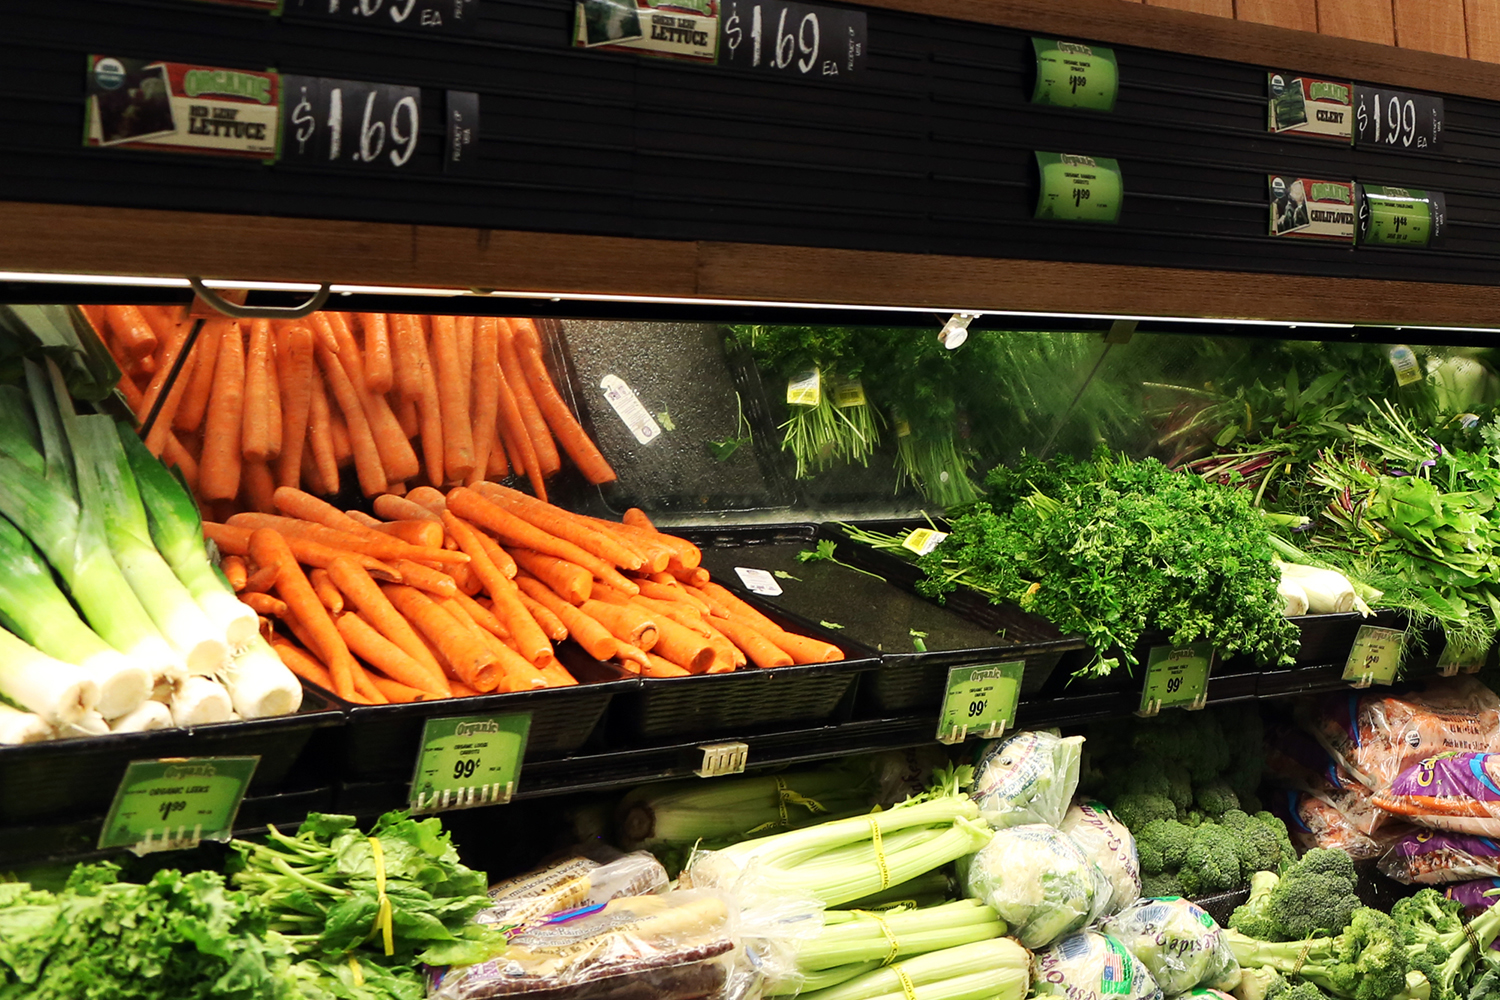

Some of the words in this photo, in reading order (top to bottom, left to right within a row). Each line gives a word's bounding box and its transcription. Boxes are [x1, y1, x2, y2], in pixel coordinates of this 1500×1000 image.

[651, 25, 708, 47] LETTUCE
[725, 2, 819, 73] $1.69
[1310, 82, 1349, 105] ORGANIC
[291, 86, 419, 167] $1.69
[1316, 109, 1344, 124] CELERY
[1357, 94, 1416, 147] $1.99
[188, 117, 266, 140] LETTUCE
[1311, 182, 1350, 205] ORGANIC
[1310, 209, 1354, 225] CAULIFLOWER
[970, 667, 1001, 682] Organic
[968, 699, 988, 717] 99¢
[455, 719, 499, 737] Organic
[453, 758, 481, 779] 99¢
[149, 786, 184, 796] ORGANIC
